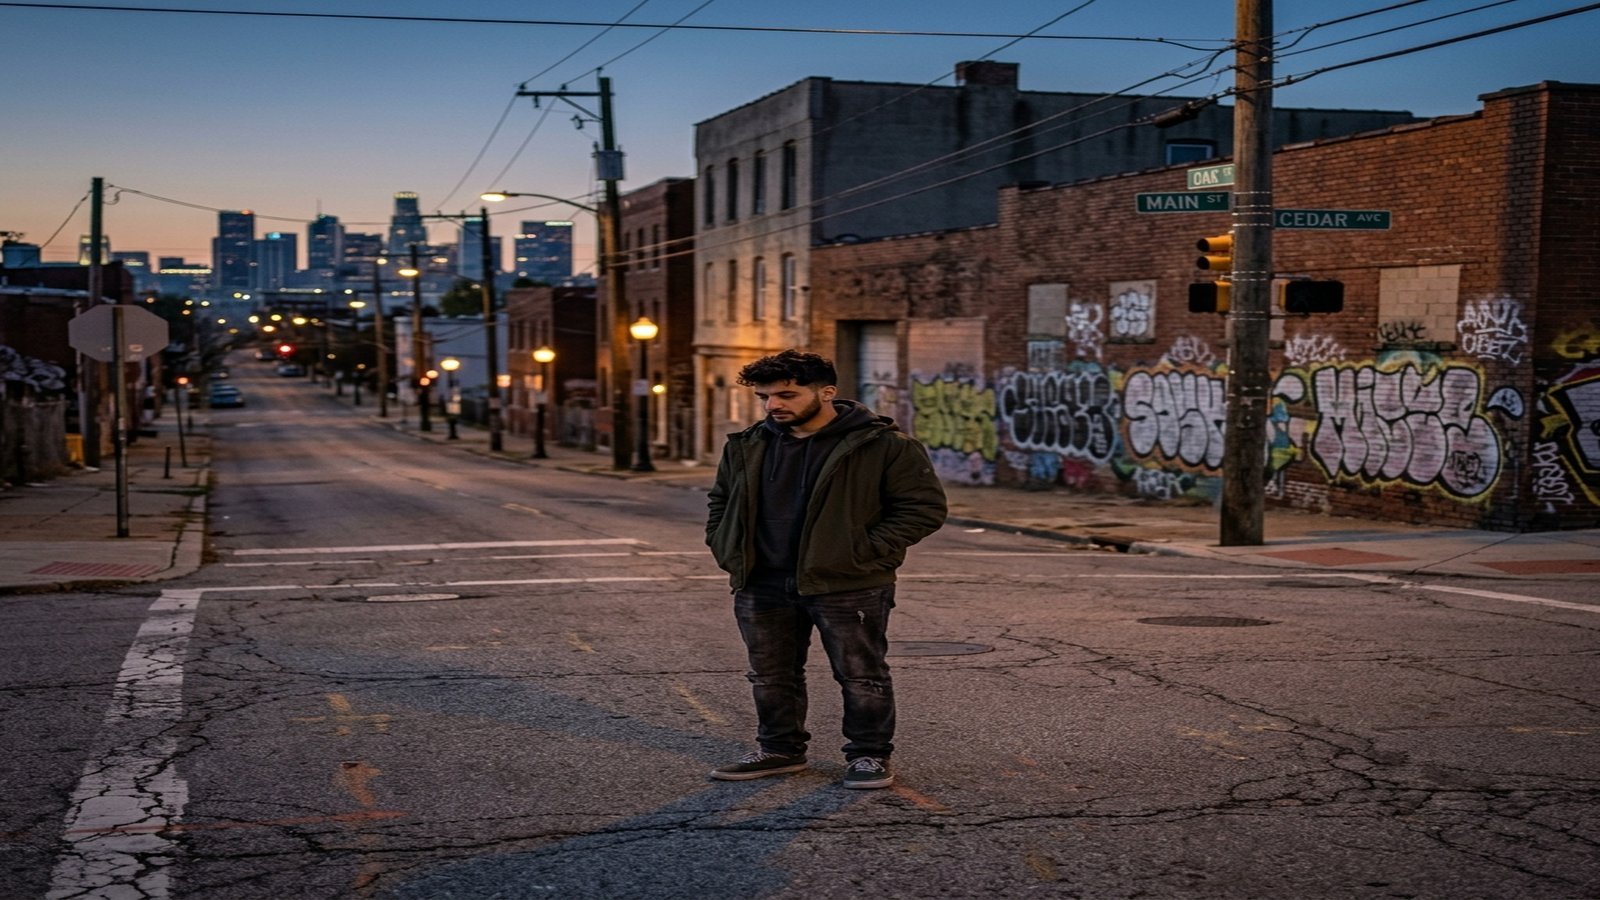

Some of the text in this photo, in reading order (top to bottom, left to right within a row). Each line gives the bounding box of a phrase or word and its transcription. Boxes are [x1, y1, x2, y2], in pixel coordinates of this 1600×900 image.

[1146, 194, 1224, 210] MAIN ST
[1280, 212, 1348, 227] CEDAR
